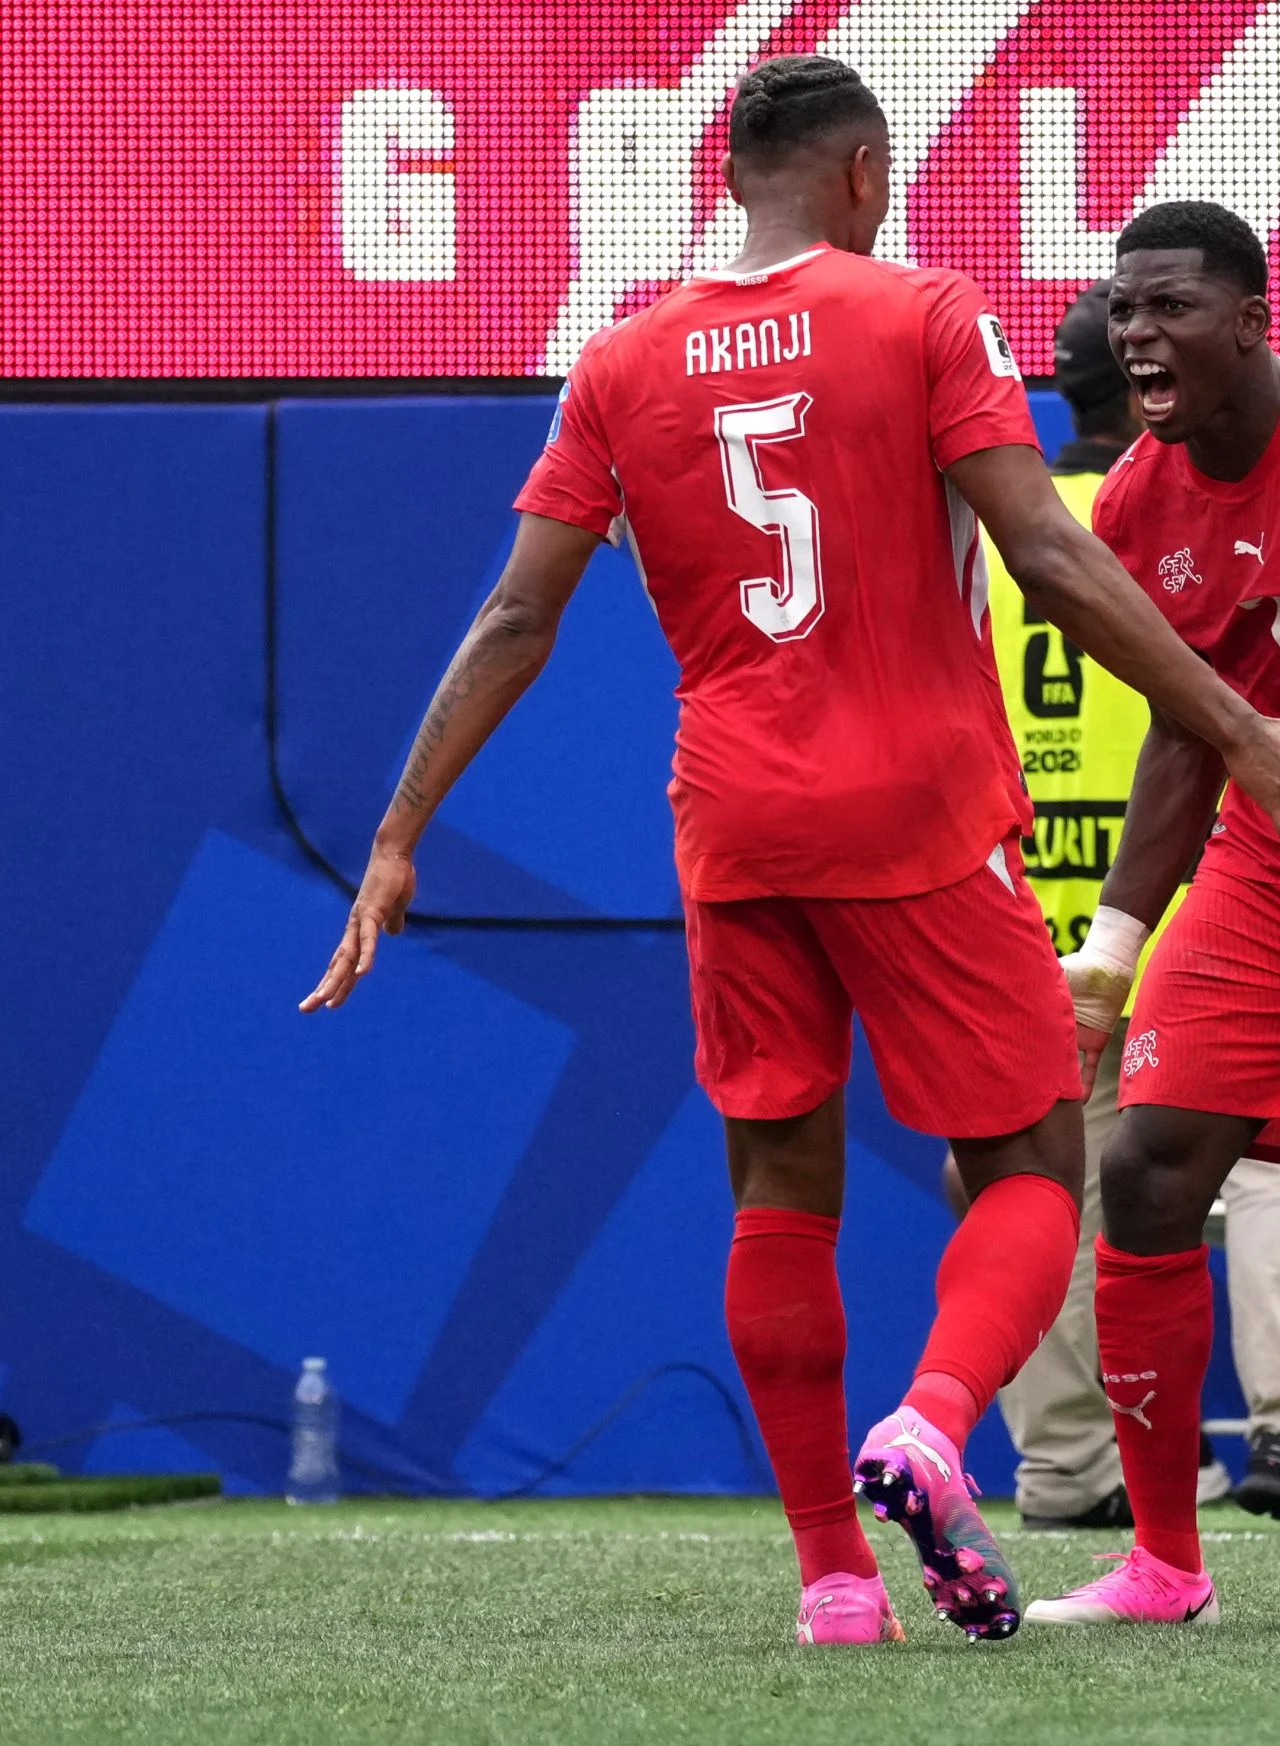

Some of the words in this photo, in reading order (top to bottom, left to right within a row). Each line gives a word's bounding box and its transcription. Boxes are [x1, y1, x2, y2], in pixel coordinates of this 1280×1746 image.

[686, 311, 812, 377] AKANJI
[713, 391, 825, 644] 5
[1102, 1370, 1157, 1383] isse
